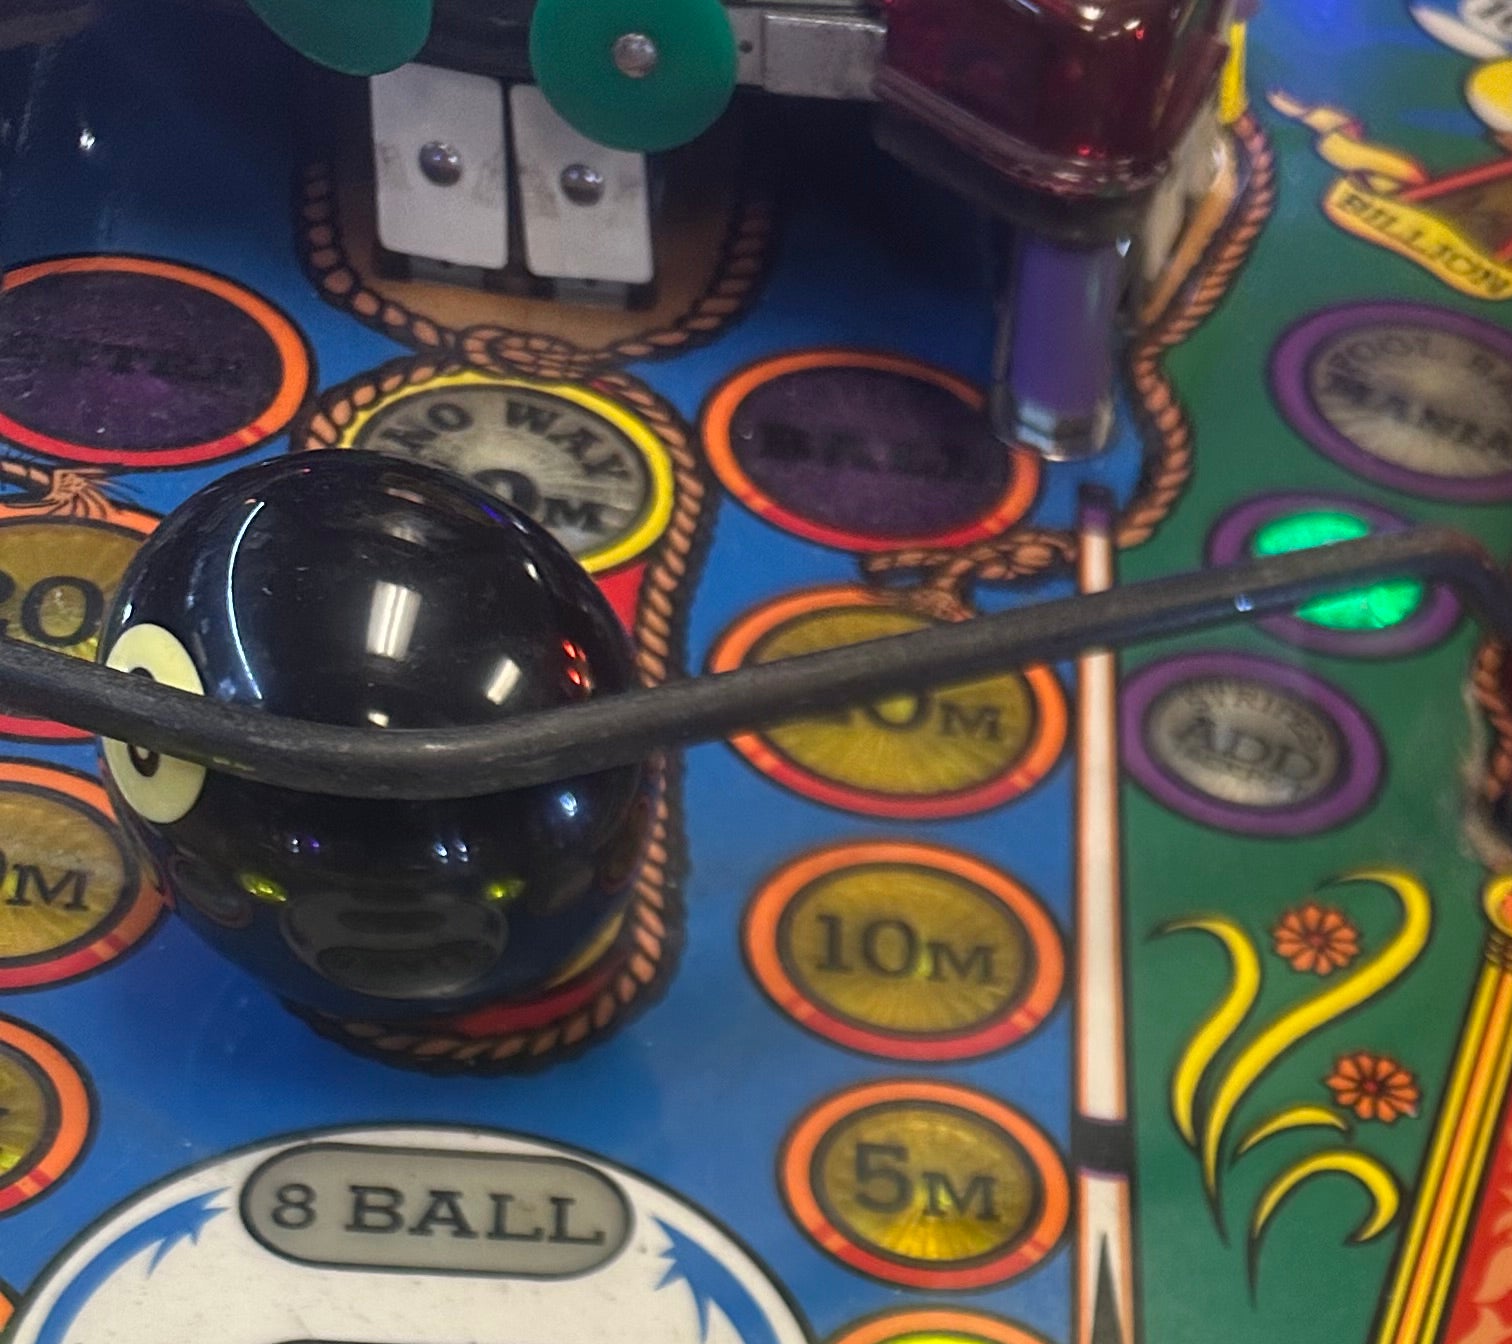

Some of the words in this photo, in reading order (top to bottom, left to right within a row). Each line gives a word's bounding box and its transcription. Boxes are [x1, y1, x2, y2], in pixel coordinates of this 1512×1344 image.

[1342, 191, 1512, 292] BILLION
[378, 402, 475, 452] NO
[505, 400, 631, 478] WAY
[1171, 713, 1320, 781] ADD
[270, 1182, 317, 1231] 8
[344, 1184, 607, 1246] BALL
